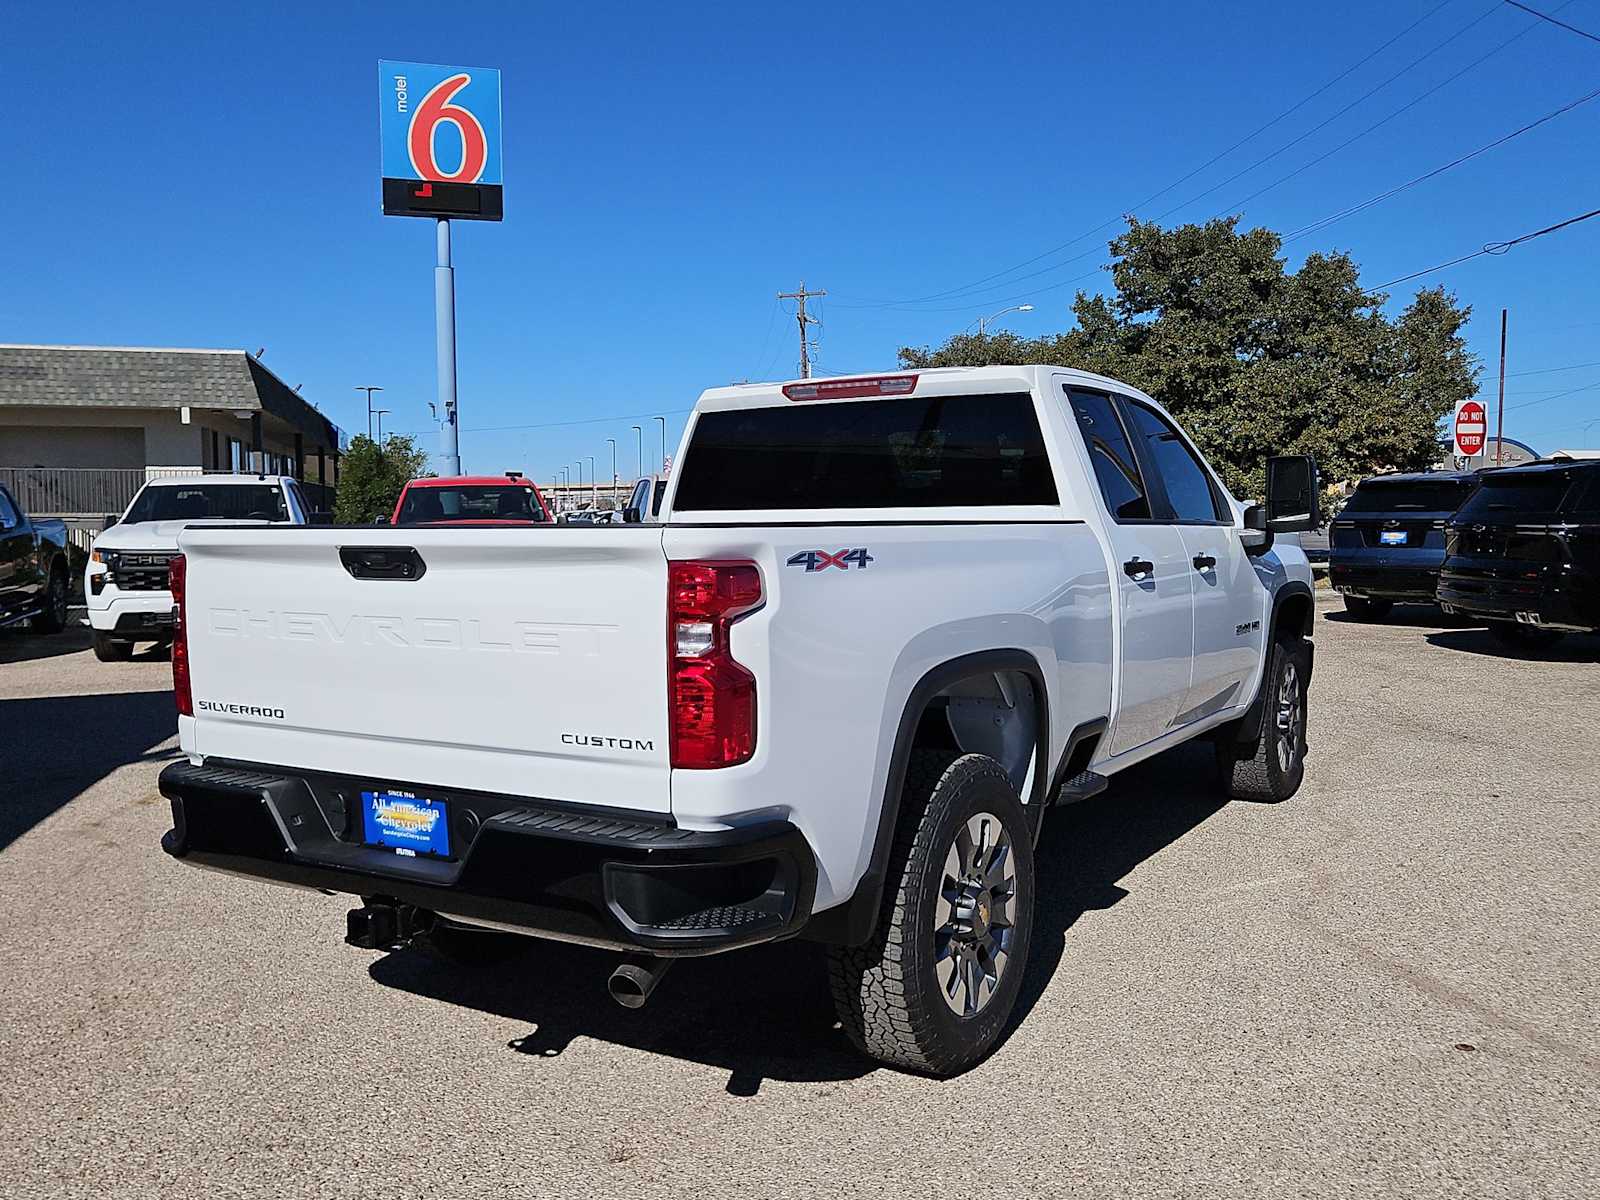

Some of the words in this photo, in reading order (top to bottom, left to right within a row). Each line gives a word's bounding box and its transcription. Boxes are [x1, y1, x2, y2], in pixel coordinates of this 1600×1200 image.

[407, 72, 488, 183] 6
[1460, 411, 1469, 421] DO
[1471, 411, 1483, 421] NOT
[1461, 436, 1481, 446] ENTER
[208, 607, 621, 657] CHEVROLET
[198, 700, 285, 719] SILVERADO
[561, 733, 655, 751] CUSTOM
[372, 798, 386, 809] All
[390, 801, 440, 818] American
[381, 814, 433, 832] Chevrolet
